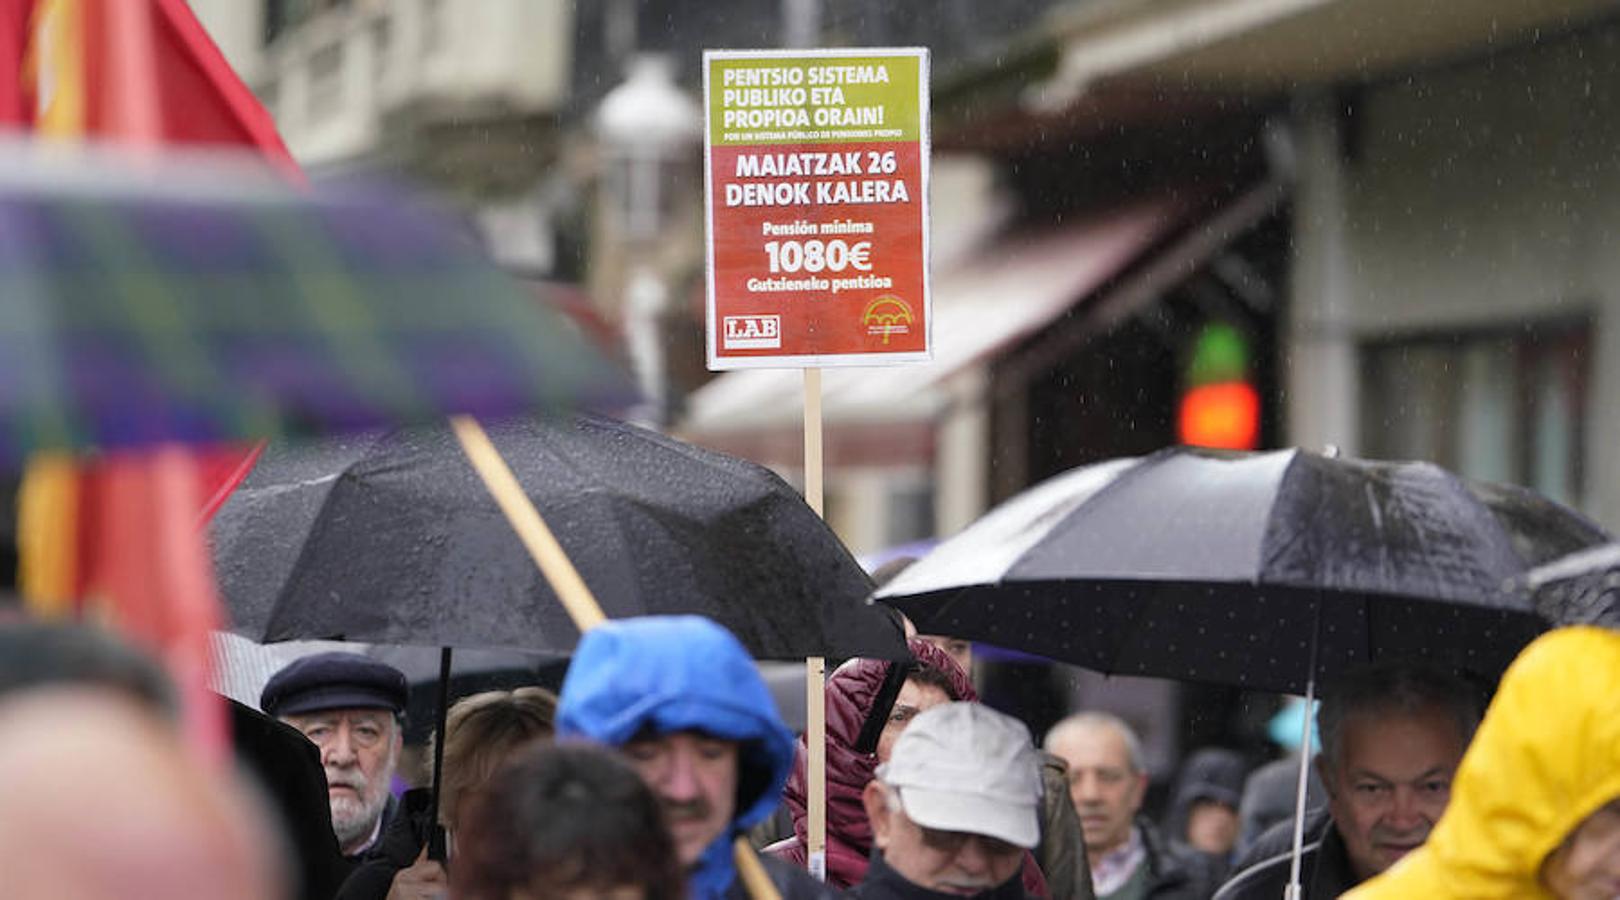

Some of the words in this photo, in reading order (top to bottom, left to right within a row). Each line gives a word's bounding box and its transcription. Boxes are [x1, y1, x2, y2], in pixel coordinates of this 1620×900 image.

[723, 67, 803, 87] PENTSIO
[807, 65, 889, 85] SISTEMA
[723, 88, 807, 107] PUBLIKO
[811, 86, 846, 105] ETA
[724, 108, 810, 128] PROPIOA
[814, 105, 884, 126] ORAIN!
[724, 133, 740, 141] POR
[736, 152, 863, 177] MAIATZAK
[867, 150, 897, 174] 26
[725, 182, 811, 206] DENOK
[816, 179, 910, 204] KALERA
[762, 220, 818, 236] Pensión
[764, 239, 873, 273] 1080€
[747, 276, 830, 292] Gutxieneko
[831, 274, 892, 293] pentsioa
[727, 319, 777, 338] LAB
